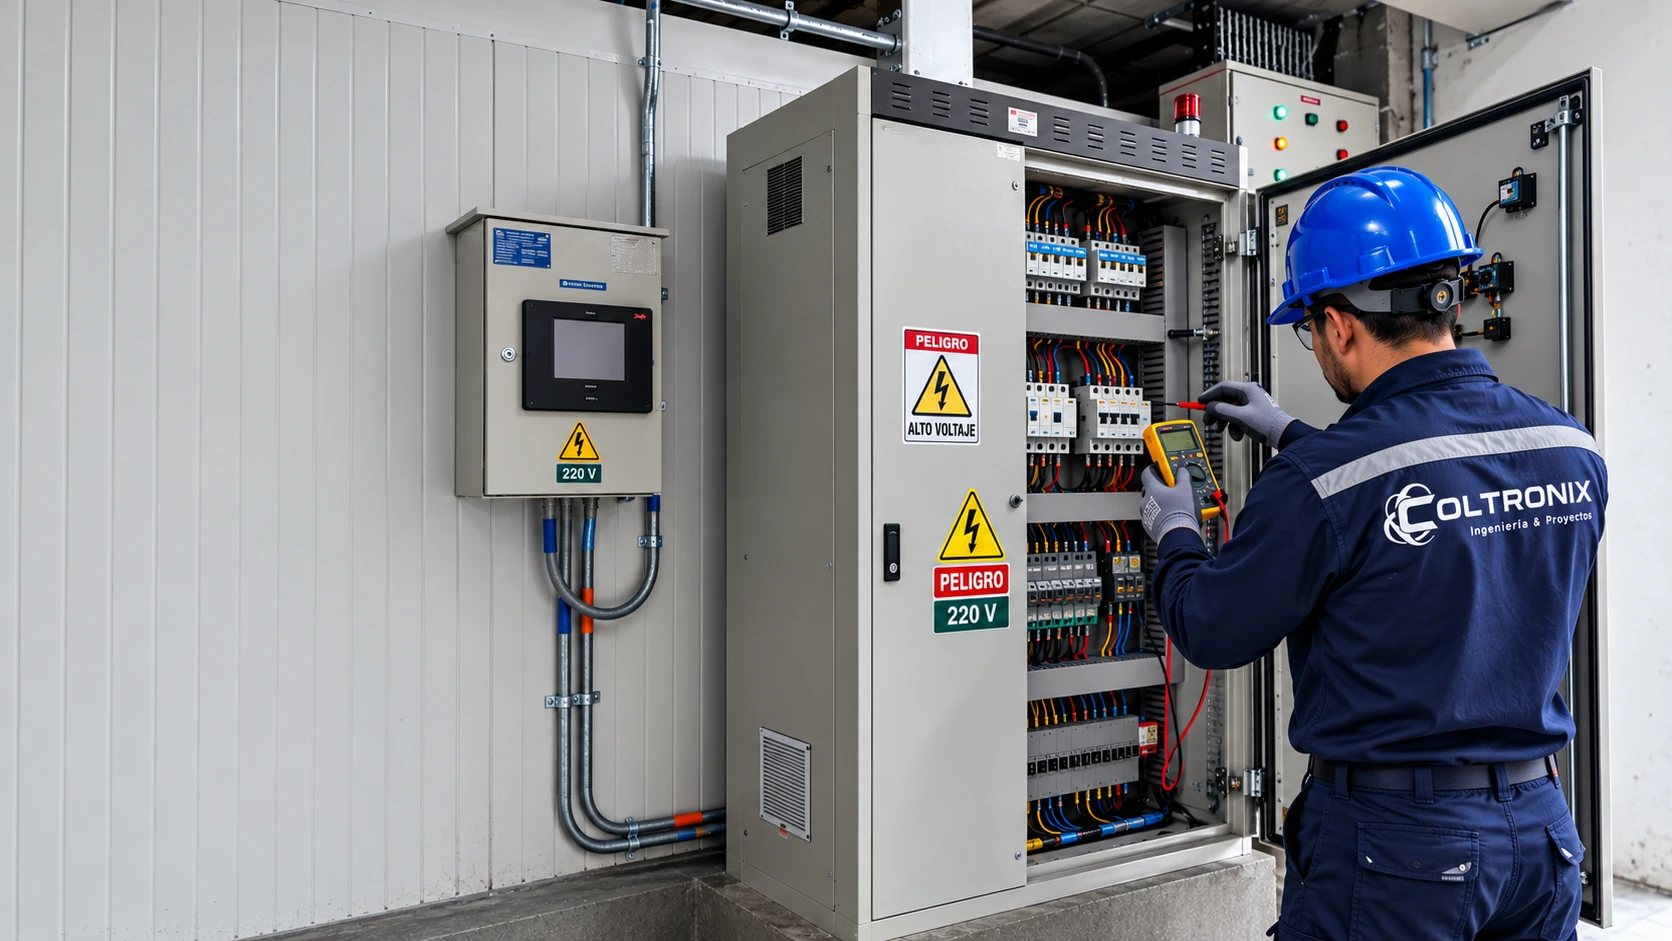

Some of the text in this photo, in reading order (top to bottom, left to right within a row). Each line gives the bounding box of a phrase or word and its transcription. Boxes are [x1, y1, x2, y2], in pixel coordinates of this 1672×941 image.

[915, 334, 969, 350] PELIGRO
[908, 422, 976, 437] ALTO VOLTAJE
[562, 467, 597, 480] 220 V
[1397, 479, 1593, 534] COLTRONIX
[1470, 511, 1593, 537] Ingeniería & Proyectos
[940, 570, 1004, 592] PELIGRO
[947, 603, 997, 626] 220 V
